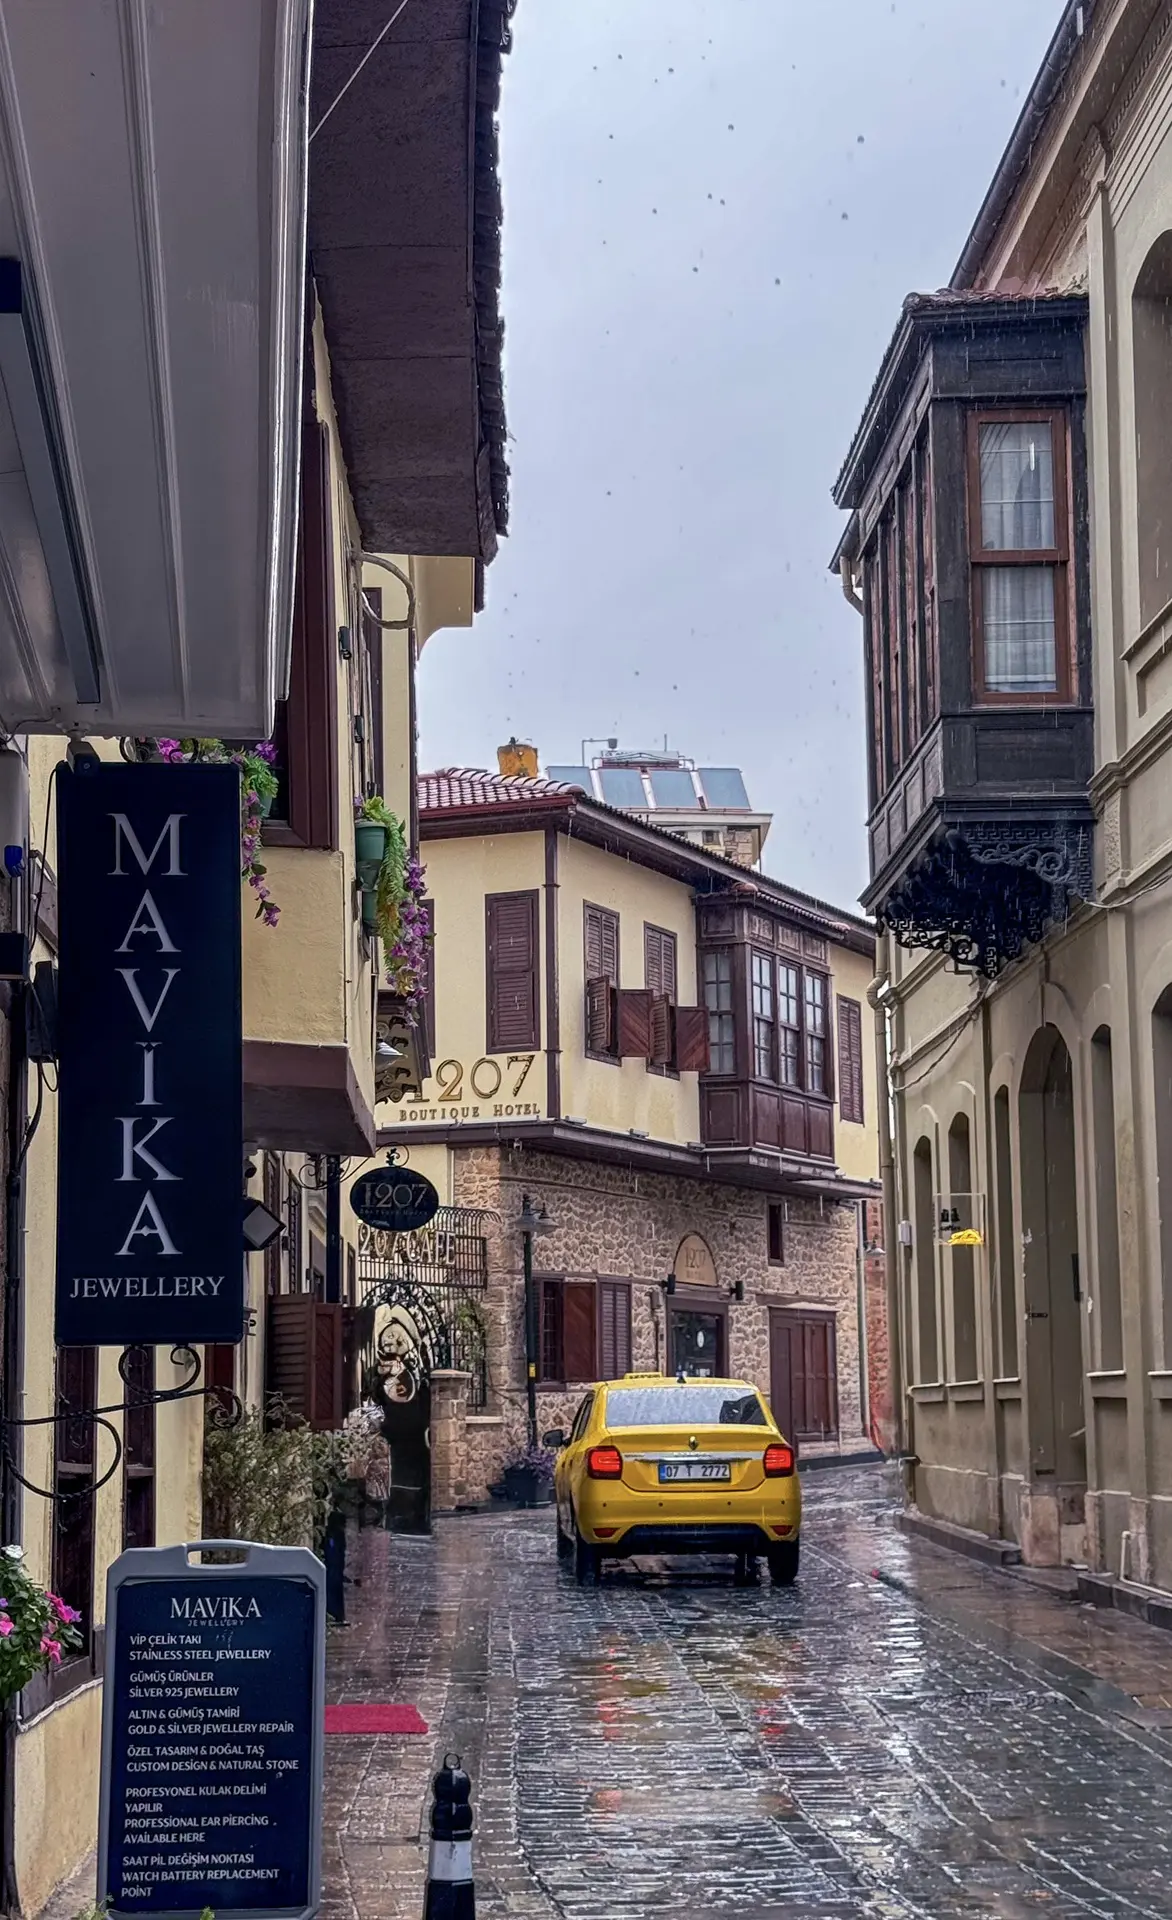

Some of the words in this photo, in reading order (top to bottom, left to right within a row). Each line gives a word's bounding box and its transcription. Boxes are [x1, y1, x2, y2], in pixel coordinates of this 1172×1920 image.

[400, 1105, 480, 1122] BOUTIQUE
[493, 1103, 541, 1117] HOTEL
[360, 1182, 428, 1208] 1207
[69, 1276, 225, 1298] JEWELLERY
[666, 1466, 679, 1477] 07
[686, 1466, 693, 1477] T
[702, 1466, 728, 1477] 2772
[188, 1619, 245, 1627] JEWELLERY
[148, 1633, 178, 1647] ÇELİK
[178, 1634, 201, 1645] TAKI
[184, 1650, 214, 1660] STEEL
[214, 1650, 272, 1662] JEWELLERY
[129, 1671, 167, 1684] GÜMÜŞ
[168, 1670, 214, 1682] ÜRÜNLER
[164, 1687, 183, 1697] 925
[183, 1687, 239, 1699] JEWELLERY
[128, 1709, 157, 1720] ALTIN
[158, 1709, 166, 1719] &
[168, 1706, 205, 1721] GÜMÜŞ
[206, 1706, 240, 1718] TAMİRİ
[128, 1724, 157, 1735] GOLD
[158, 1724, 166, 1734] &
[201, 1723, 257, 1735] JEWELLERY
[127, 1745, 153, 1757] ÖZEL
[155, 1746, 199, 1756] TASARIM
[200, 1745, 208, 1755] &
[209, 1743, 244, 1755] DOĞAL
[245, 1745, 265, 1757] TAŞ
[126, 1761, 170, 1772] CUSTOM
[209, 1760, 217, 1770] &
[218, 1760, 264, 1770] NATURAL
[266, 1759, 299, 1770] STONE
[125, 1786, 197, 1797] PROFESYONEL
[199, 1785, 232, 1796] KULAK
[233, 1783, 267, 1795] DELİMİ
[125, 1802, 163, 1813] YAPILIR
[201, 1816, 221, 1827] EAR
[179, 1832, 206, 1843] HERE
[122, 1855, 149, 1866] SAAT
[150, 1853, 166, 1866] PİL
[168, 1852, 209, 1867] DEĞİŞİM
[211, 1853, 254, 1864] NOKTASI
[121, 1871, 160, 1882] WATCH
[161, 1870, 205, 1881] BATTERY
[207, 1868, 280, 1879] REPLACEMENT
